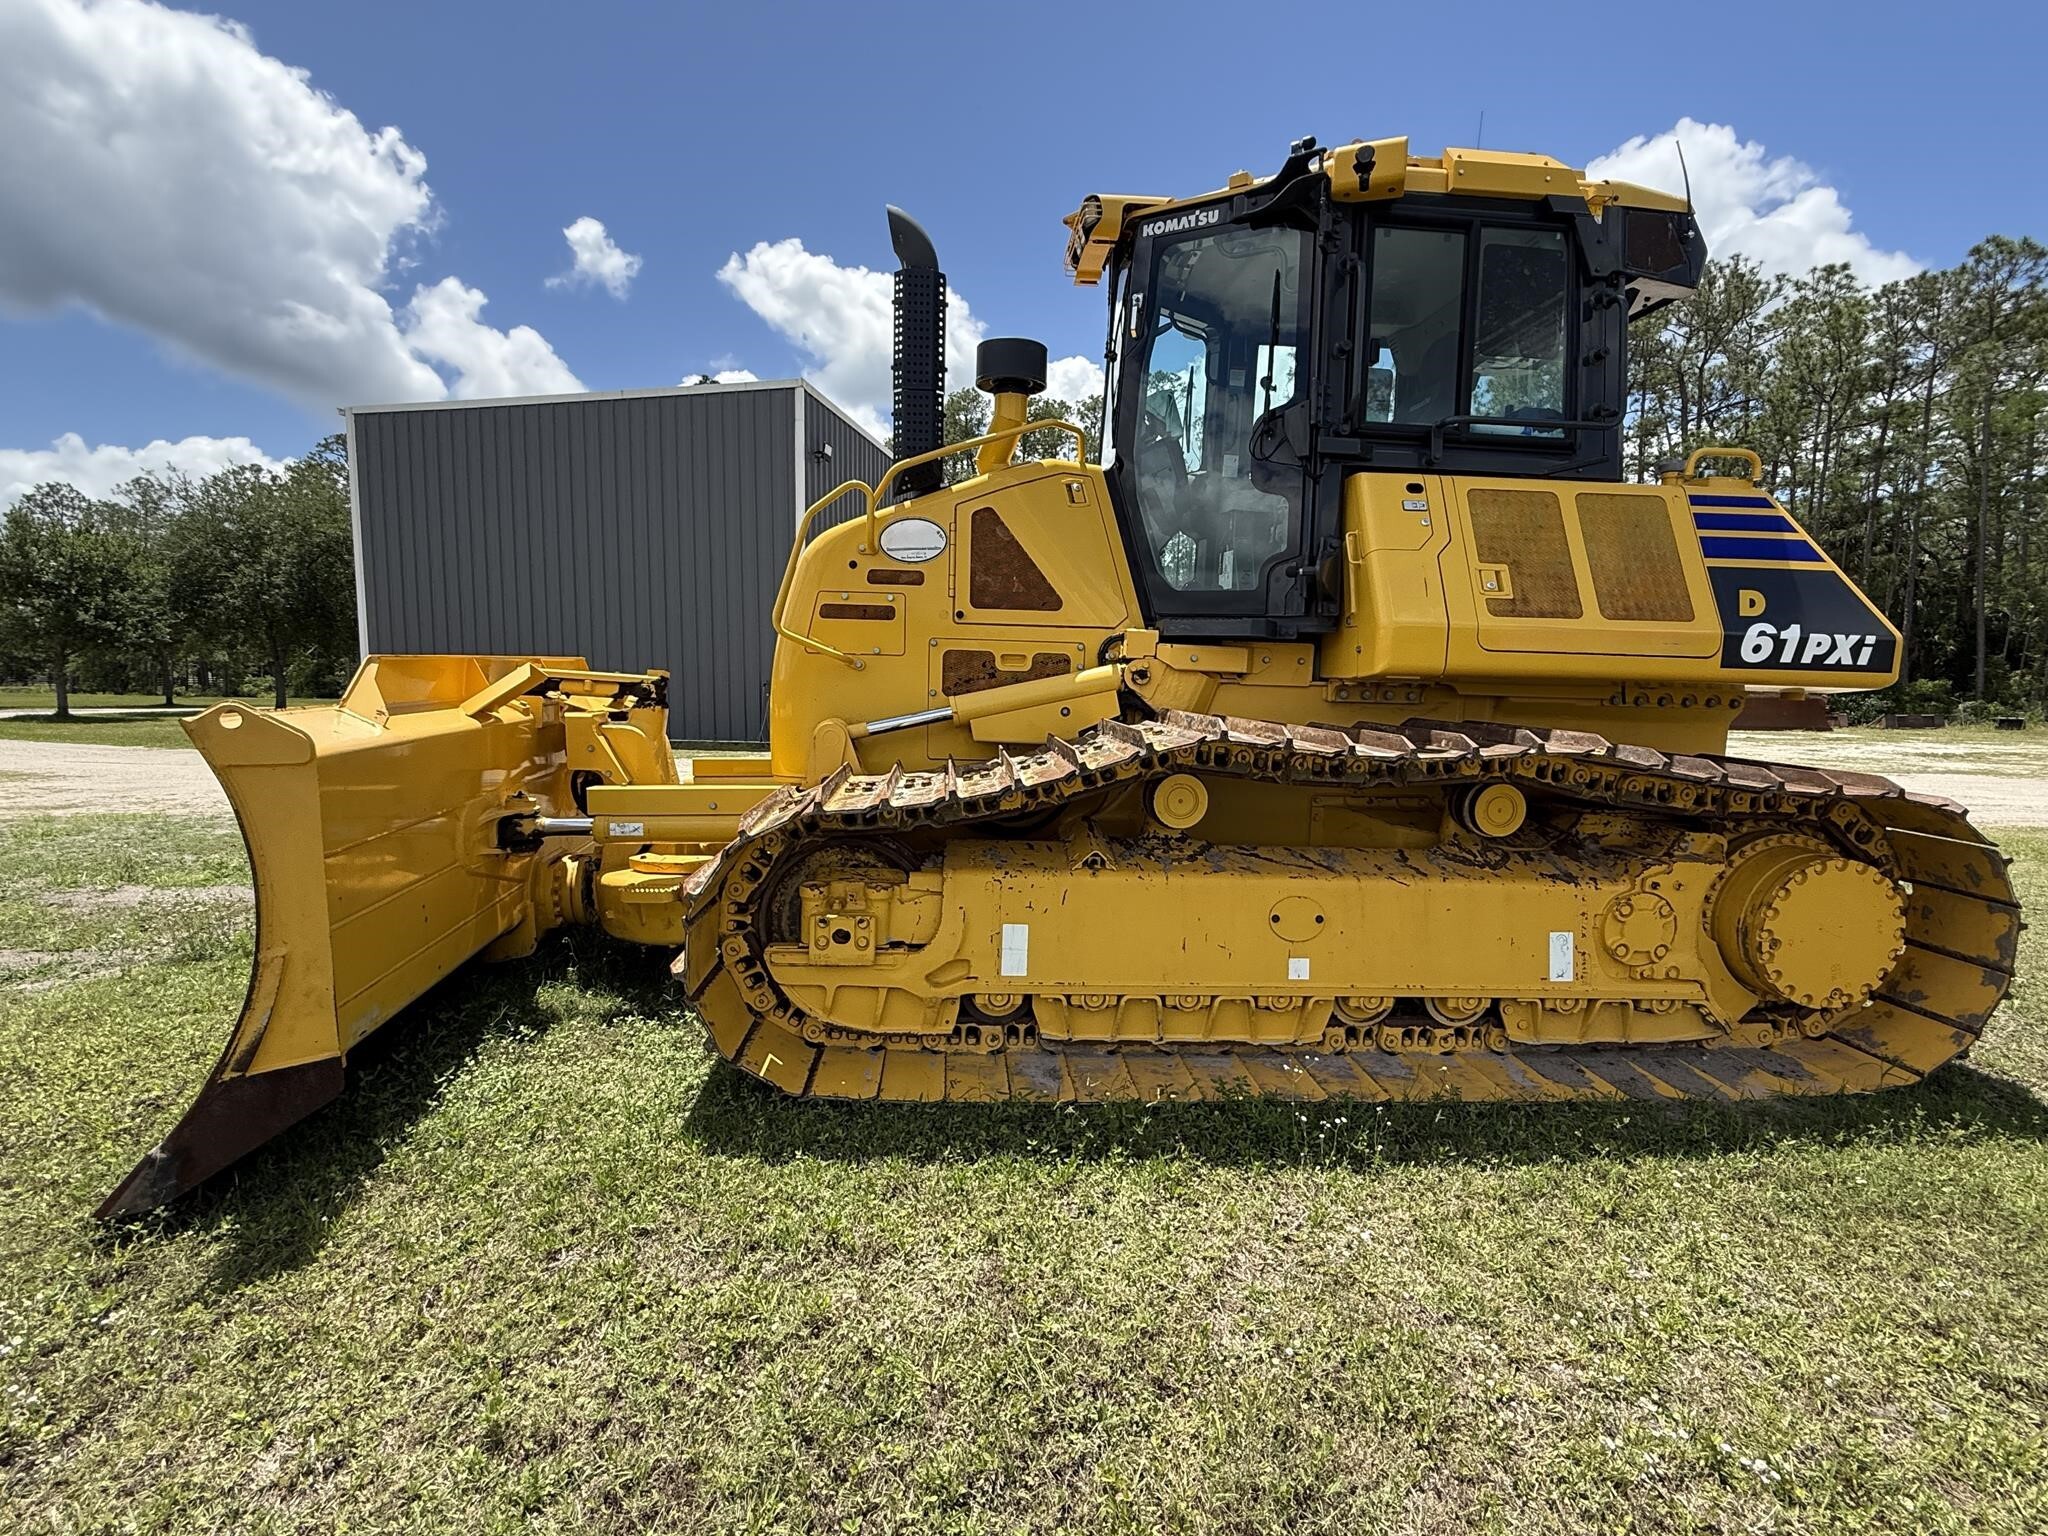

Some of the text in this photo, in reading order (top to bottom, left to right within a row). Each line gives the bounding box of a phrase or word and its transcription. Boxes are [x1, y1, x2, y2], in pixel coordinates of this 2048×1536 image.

[1142, 209, 1219, 237] KOMATSU
[1739, 590, 1766, 616] D
[1740, 622, 1876, 666] 61PXi
